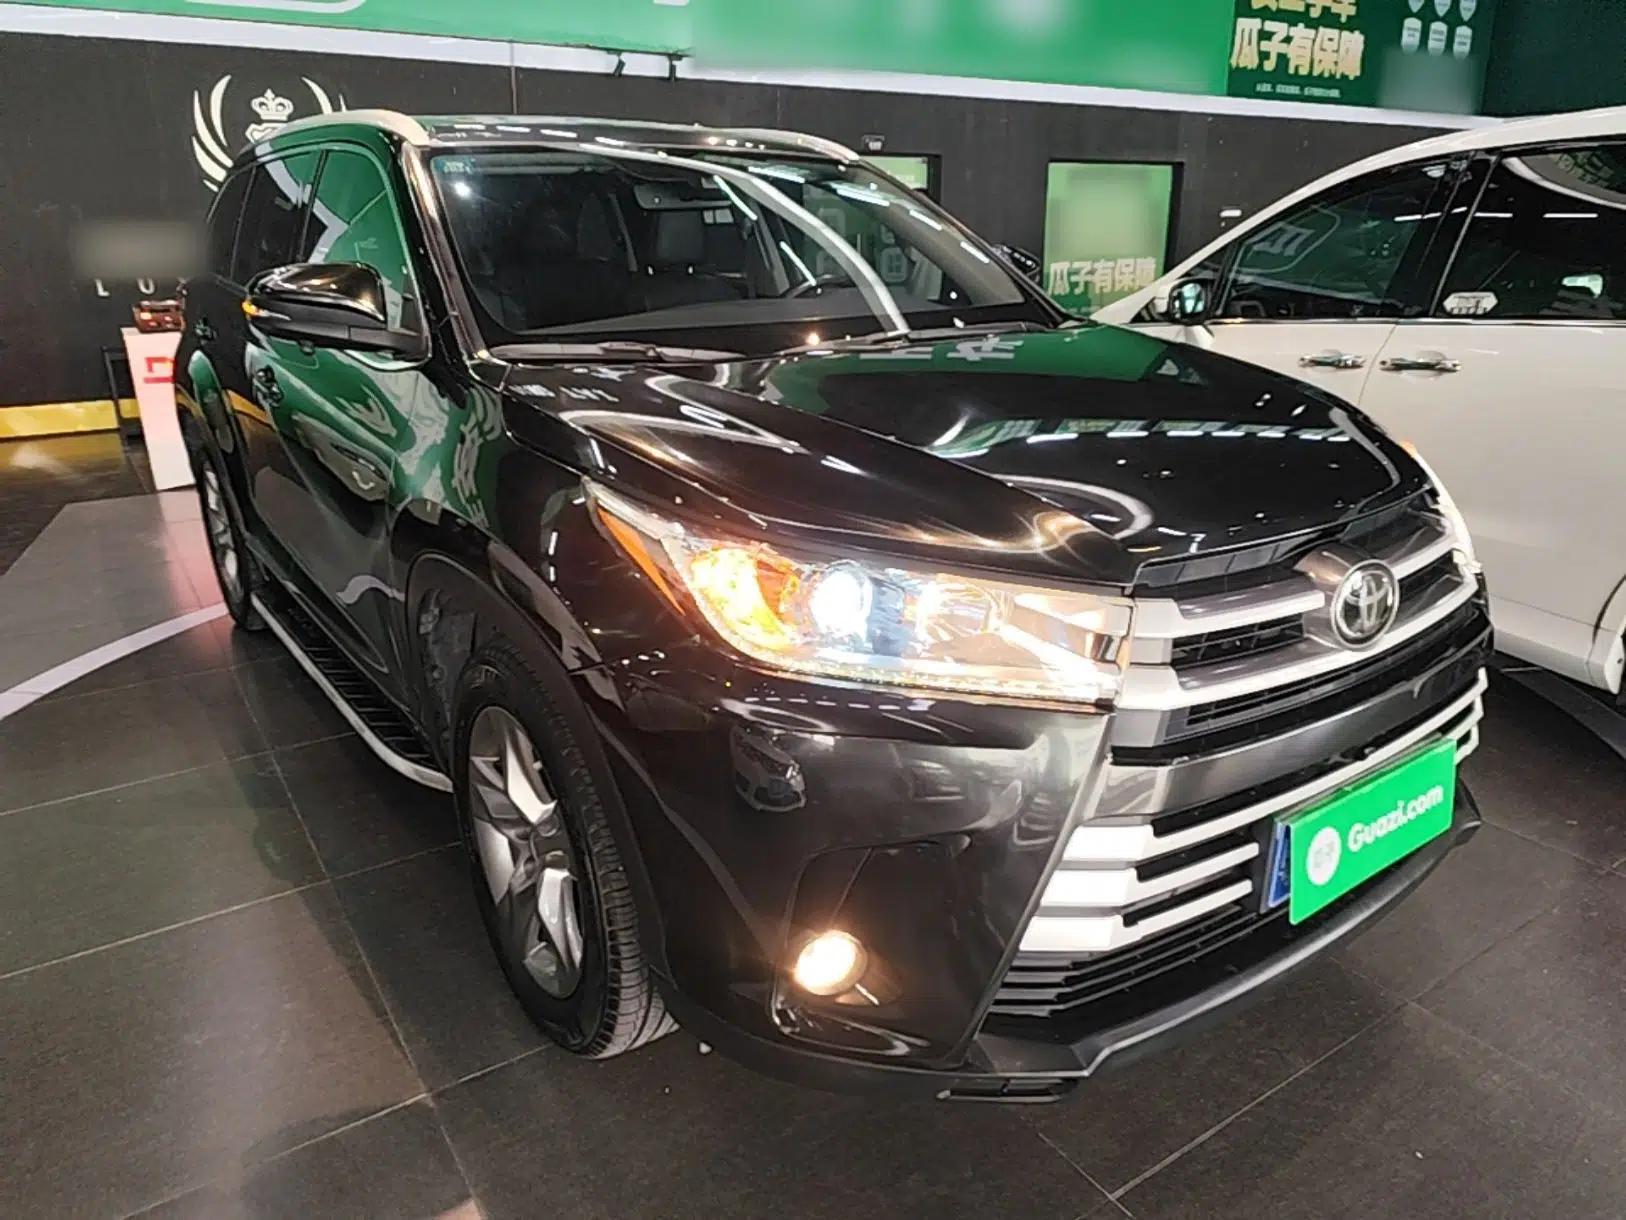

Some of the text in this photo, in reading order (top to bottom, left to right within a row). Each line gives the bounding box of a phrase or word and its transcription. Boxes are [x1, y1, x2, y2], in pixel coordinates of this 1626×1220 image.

[1230, 17, 1365, 80] 瓜子有保障
[1048, 257, 1156, 295] 瓜子有保障
[1348, 785, 1444, 852] Guazi.com
